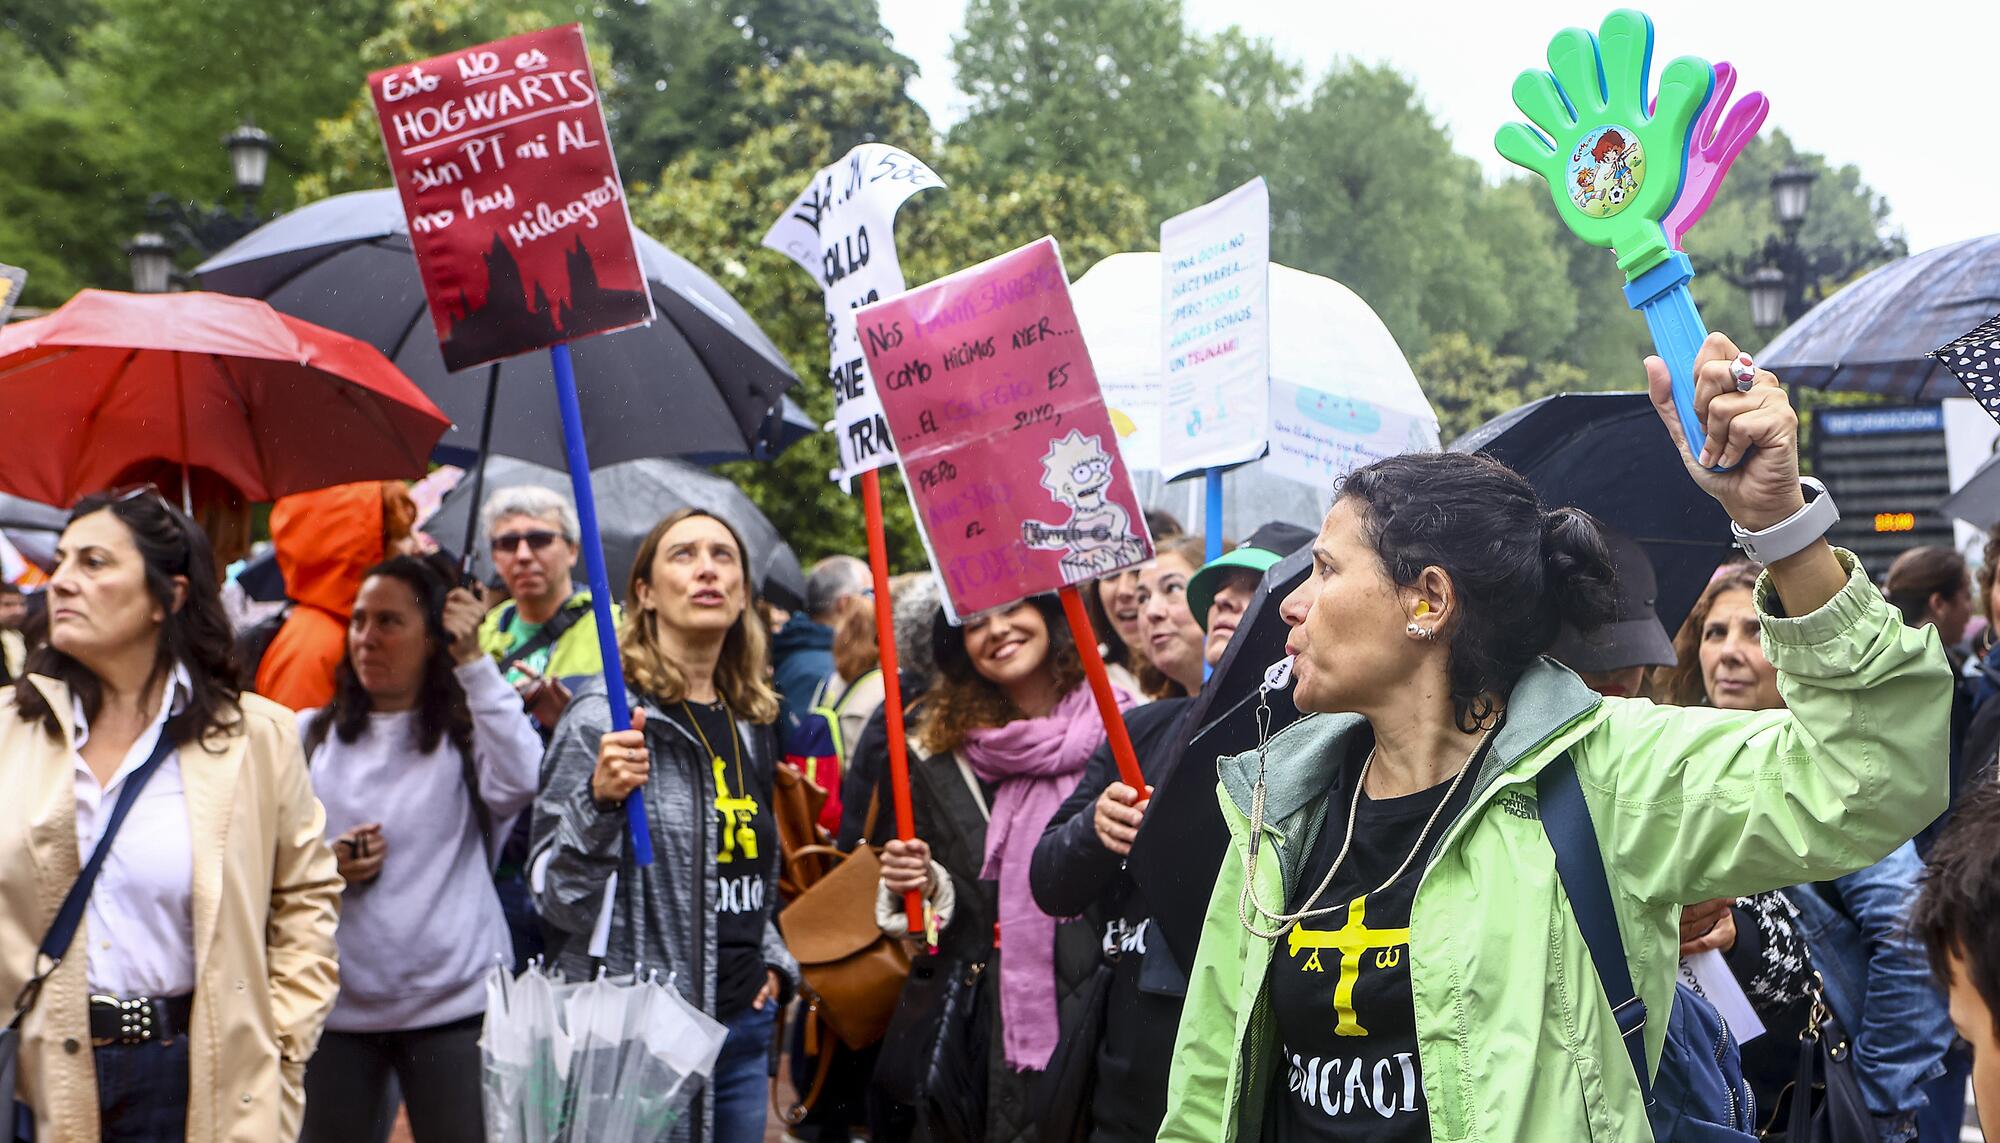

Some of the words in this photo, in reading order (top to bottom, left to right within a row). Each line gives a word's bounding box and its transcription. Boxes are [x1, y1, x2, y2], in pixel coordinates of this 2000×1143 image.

[382, 66, 441, 101] Esto
[457, 51, 500, 80] NO
[393, 69, 595, 147] HOGWARTS
[412, 157, 463, 193] sin
[459, 133, 505, 174] PT
[557, 120, 600, 155] AL
[413, 209, 455, 233] no
[461, 184, 515, 220] hay
[1048, 362, 1071, 391] ES
[919, 459, 957, 492] PERO
[966, 521, 986, 539] EL
